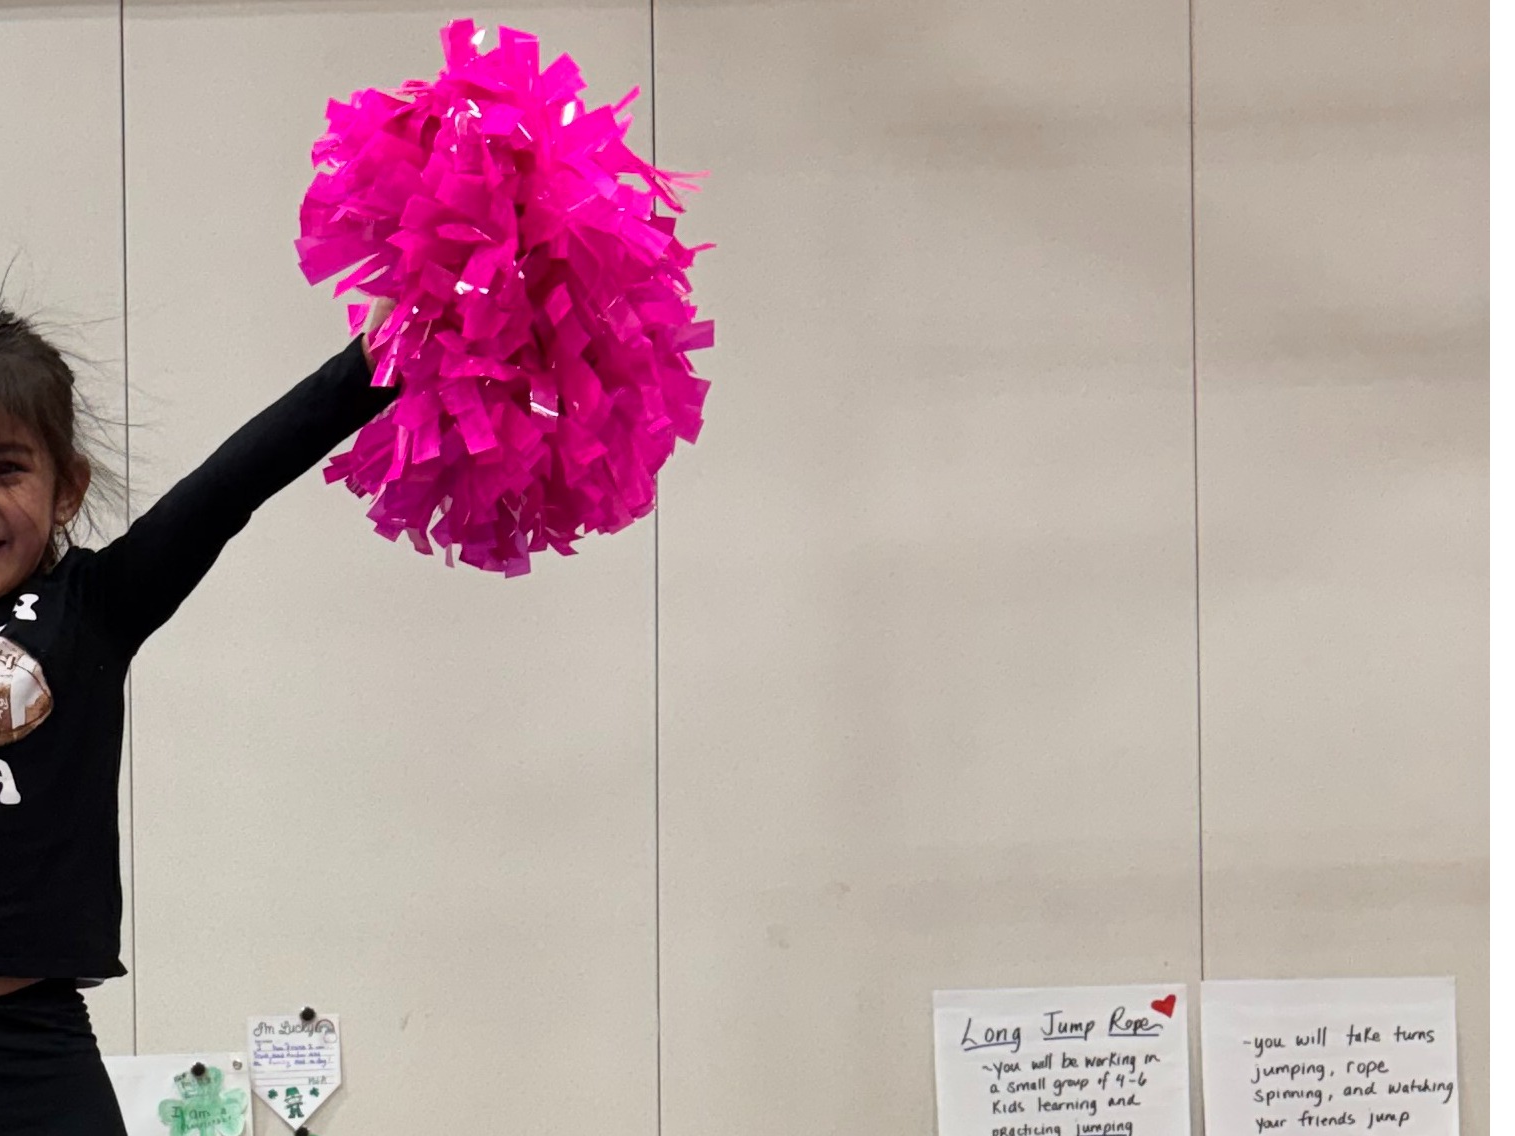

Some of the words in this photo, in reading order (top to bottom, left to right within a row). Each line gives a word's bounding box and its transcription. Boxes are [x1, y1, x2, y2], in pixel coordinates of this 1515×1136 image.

[279, 1020, 314, 1037] Lucky
[961, 1018, 1021, 1052] Long
[1041, 1010, 1095, 1040] Jump
[1109, 1006, 1163, 1035] Rope
[1296, 1027, 1327, 1047] will
[1346, 1024, 1381, 1046] take
[1394, 1025, 1435, 1044] turns
[1031, 1052, 1052, 1070] will
[1062, 1052, 1079, 1068] be
[1085, 1053, 1136, 1074] working
[1251, 1062, 1335, 1084] jumping,
[1346, 1059, 1390, 1079] rope
[990, 1083, 999, 1094] a
[1008, 1077, 1046, 1093] small
[1053, 1079, 1089, 1096] group
[1097, 1072, 1109, 1088] of
[1343, 1081, 1377, 1096] and
[1388, 1078, 1454, 1104] watching
[1038, 1098, 1098, 1116] learning
[1108, 1095, 1141, 1107] and
[1298, 1110, 1356, 1127] friends
[1367, 1108, 1410, 1129] jump
